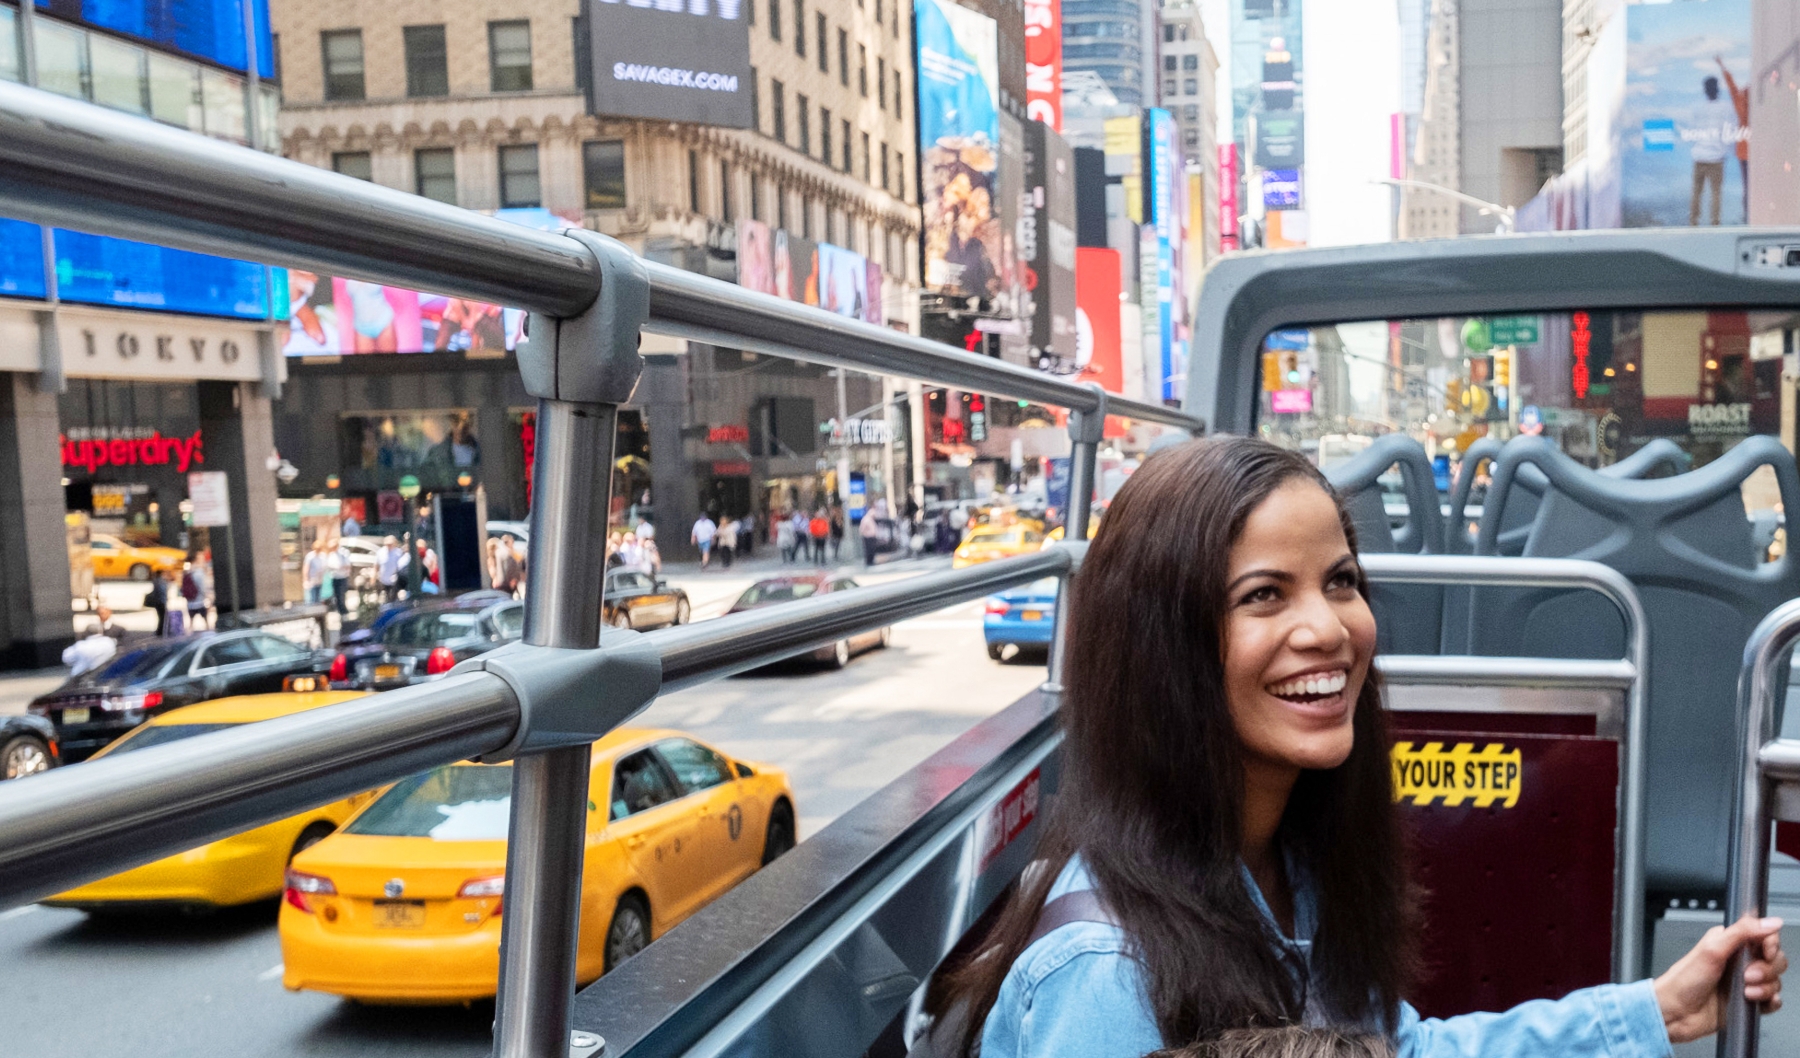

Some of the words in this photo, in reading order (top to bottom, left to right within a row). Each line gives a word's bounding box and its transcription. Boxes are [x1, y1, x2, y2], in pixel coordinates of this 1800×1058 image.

[613, 62, 739, 92] SAVAGEX.COM
[82, 328, 240, 365] TOKYO
[1397, 759, 1456, 788] YOUR
[1464, 760, 1518, 789] STEP
